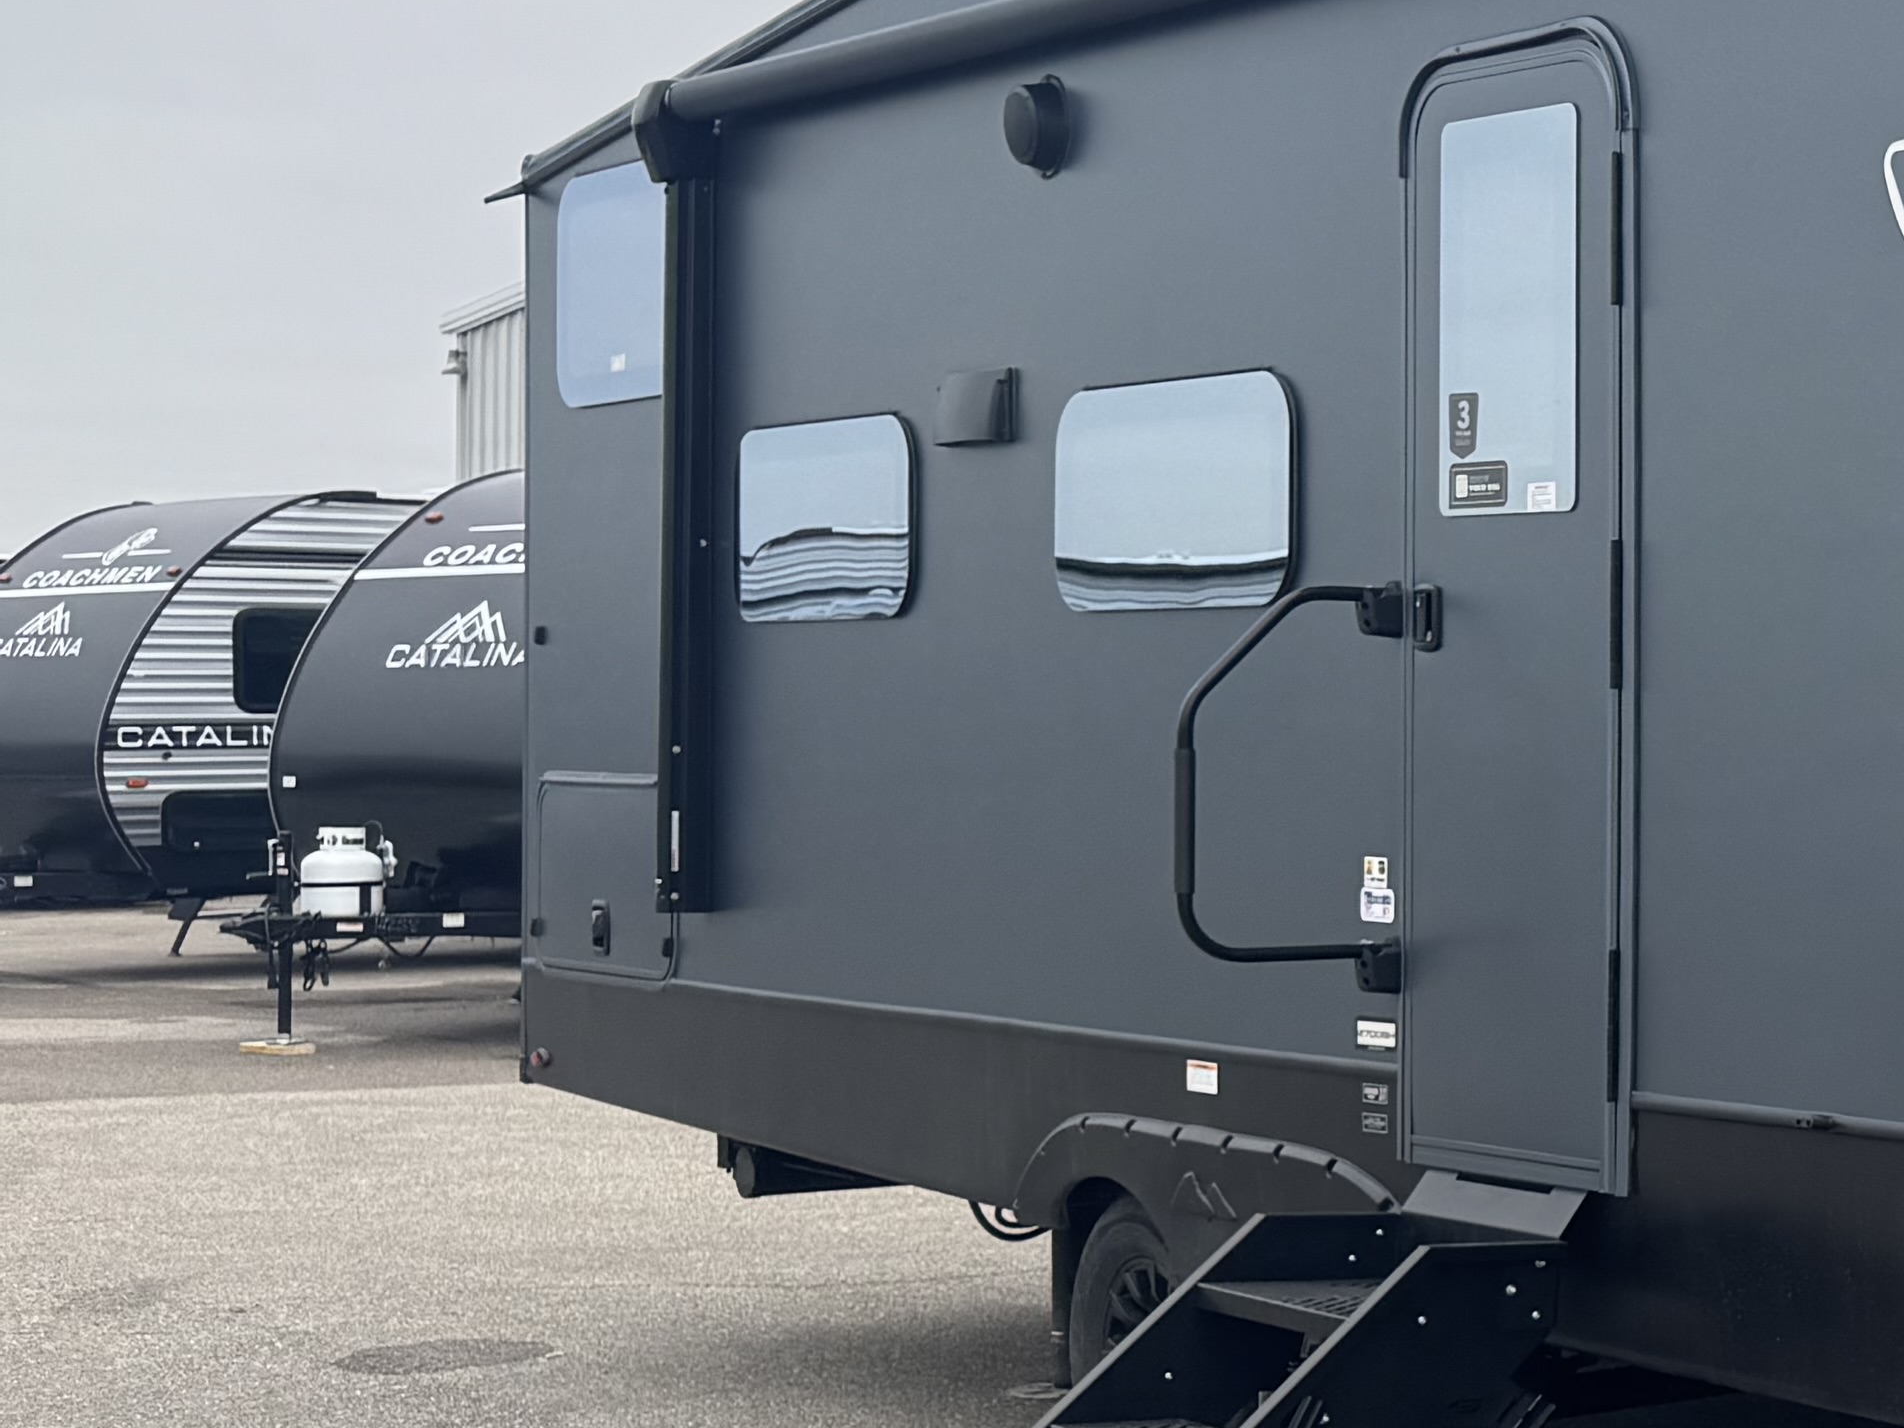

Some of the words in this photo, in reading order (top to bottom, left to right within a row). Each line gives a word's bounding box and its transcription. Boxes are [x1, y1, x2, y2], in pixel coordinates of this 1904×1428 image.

[1456, 399, 1471, 430] 3
[22, 565, 162, 589] COACHMEN
[0, 637, 83, 658] ATALINA
